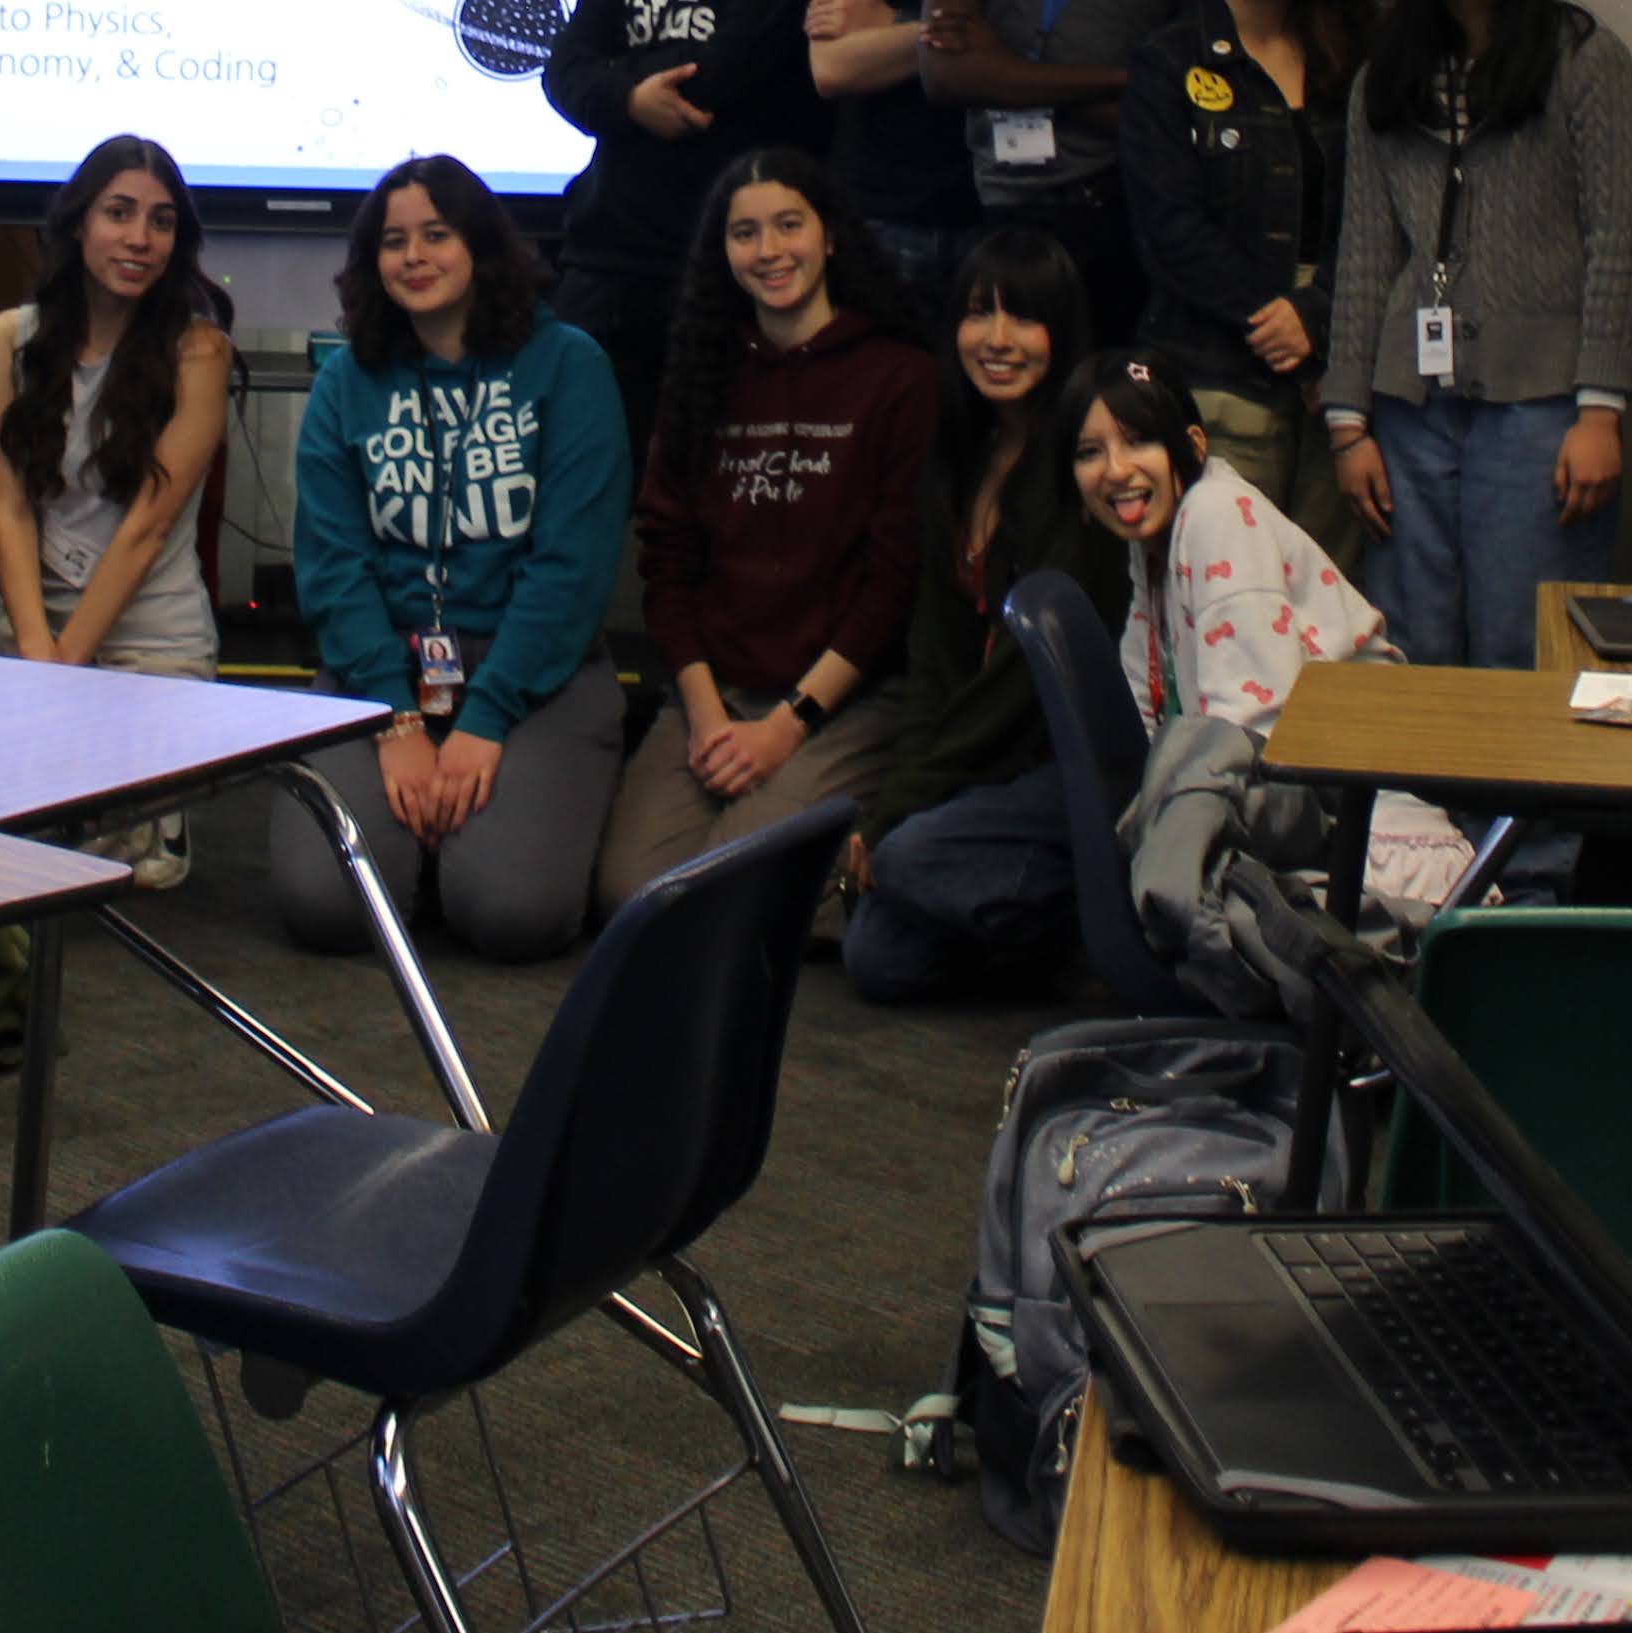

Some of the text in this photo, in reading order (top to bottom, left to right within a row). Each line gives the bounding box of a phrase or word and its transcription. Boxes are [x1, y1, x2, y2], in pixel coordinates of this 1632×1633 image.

[45, 1, 172, 39] Physics,
[115, 48, 140, 80] &
[155, 49, 278, 88] Coding
[465, 442, 525, 480] BE
[369, 472, 537, 548] KIND
